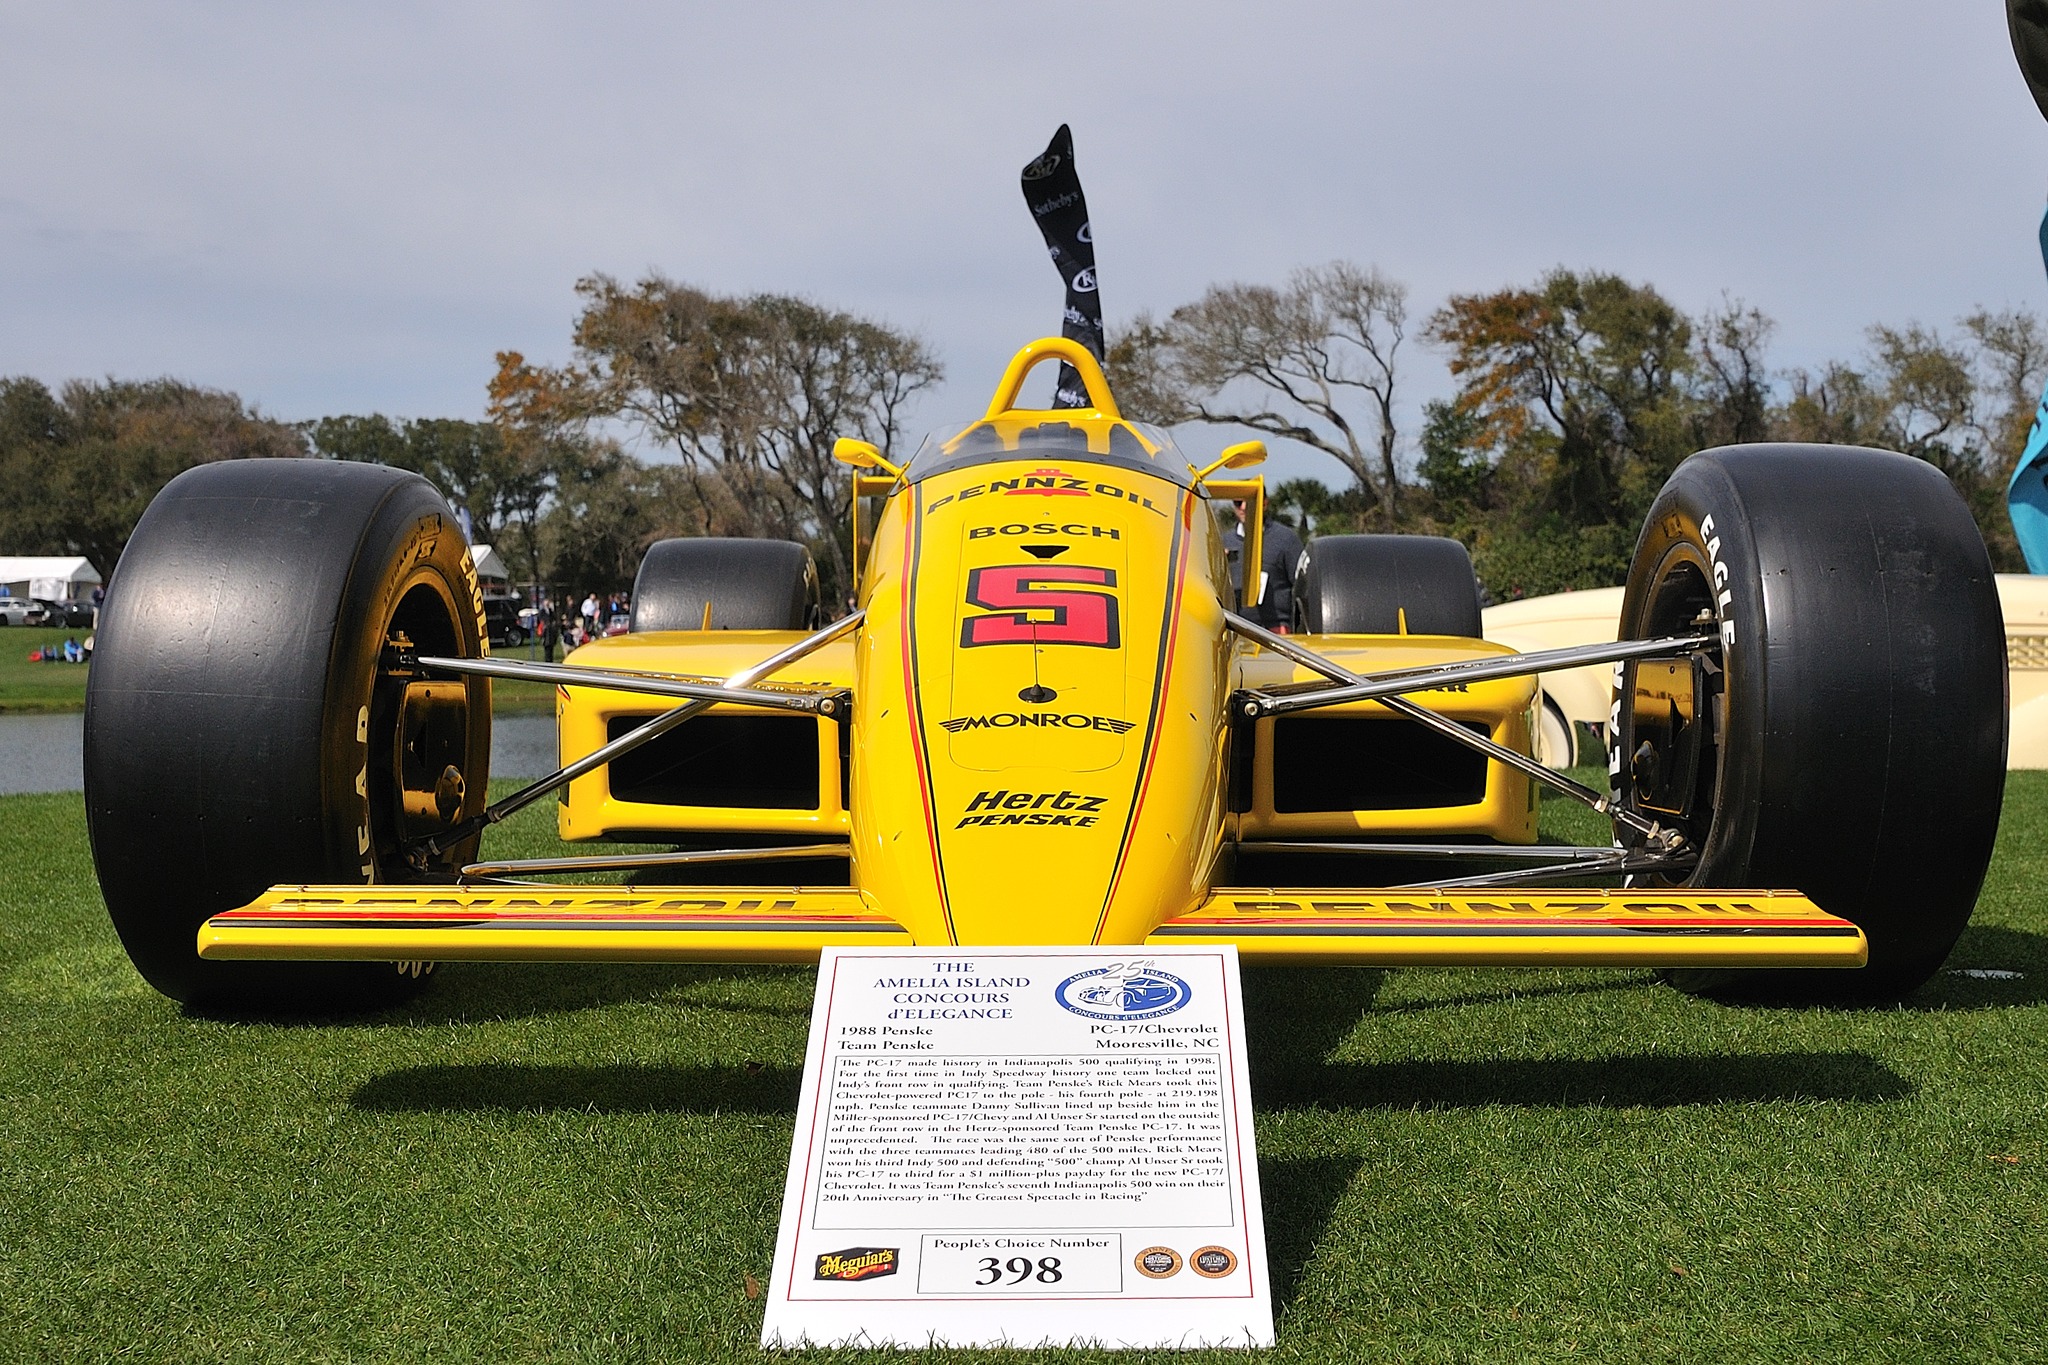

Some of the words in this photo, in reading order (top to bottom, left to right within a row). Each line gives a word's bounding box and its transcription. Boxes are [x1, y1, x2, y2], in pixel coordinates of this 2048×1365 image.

[926, 476, 1168, 518] PENNZOIL
[968, 523, 1120, 540] BOSCH
[1700, 512, 1736, 647] EAGLE
[458, 545, 491, 657] EAGLE
[960, 564, 1121, 648] 5
[961, 713, 1113, 734] MONROE
[965, 790, 1108, 812] Hertz
[955, 814, 1100, 830] PENSKE
[932, 962, 975, 973] THE
[1068, 968, 1105, 983] AMELIA
[1144, 969, 1179, 982] ISLAND
[874, 978, 950, 988] AMELIA
[956, 977, 1030, 988] ISLAND
[894, 993, 1010, 1003] CONCOURS
[888, 1008, 1013, 1019] d'ELEGANCE
[1068, 1006, 1120, 1021] CONCOURS
[1122, 1005, 1180, 1020] d'ELEGANCE
[841, 1026, 877, 1036] 1988
[882, 1026, 933, 1035] Penske
[1090, 1024, 1218, 1034] PC-17/Chevrolet
[838, 1040, 877, 1050] Team
[883, 1040, 934, 1050] Penske
[1096, 1039, 1188, 1049] Mooresville,
[1193, 1038, 1220, 1048] NC
[942, 1059, 981, 1068] history
[1004, 1058, 1072, 1068] Indianapolis
[1105, 1057, 1161, 1067] qualifying
[961, 1069, 986, 1078] Indy
[992, 1069, 1046, 1078] Speedway
[1052, 1069, 1090, 1078] history
[837, 1080, 870, 1090] Indy's
[948, 1080, 1008, 1090] qualifying.
[835, 1091, 942, 1101] Chevrolet-powered
[1021, 1091, 1044, 1100] pole
[1119, 1090, 1143, 1099] pole
[834, 1102, 864, 1112] mph.
[972, 1102, 1009, 1111] Danny
[833, 1113, 929, 1123] Miller-sponsored
[932, 1113, 1009, 1123] PC-17/Chevy
[966, 1124, 1059, 1134] Hertz-sponsored
[829, 1135, 918, 1145] unprecedented.
[1149, 1133, 1221, 1143] performance
[980, 1146, 1022, 1156] leading
[907, 1158, 933, 1168] Indy
[986, 1157, 1044, 1168] defending
[1085, 1157, 1124, 1167] champ
[988, 1169, 1060, 1179] million-plus
[1064, 1168, 1105, 1179] payday
[823, 1181, 884, 1190] Chevrolet.
[1054, 1180, 1127, 1190] Indianapolis
[852, 1193, 923, 1204] Anniversary
[1026, 1192, 1080, 1202] Spectacle
[1100, 1191, 1147, 1202] Racing"
[934, 1239, 990, 1251] People's
[995, 1238, 1045, 1248] Choice
[1050, 1238, 1110, 1248] Number
[819, 1249, 894, 1278] Meguiar's
[976, 1257, 1063, 1286] 398
